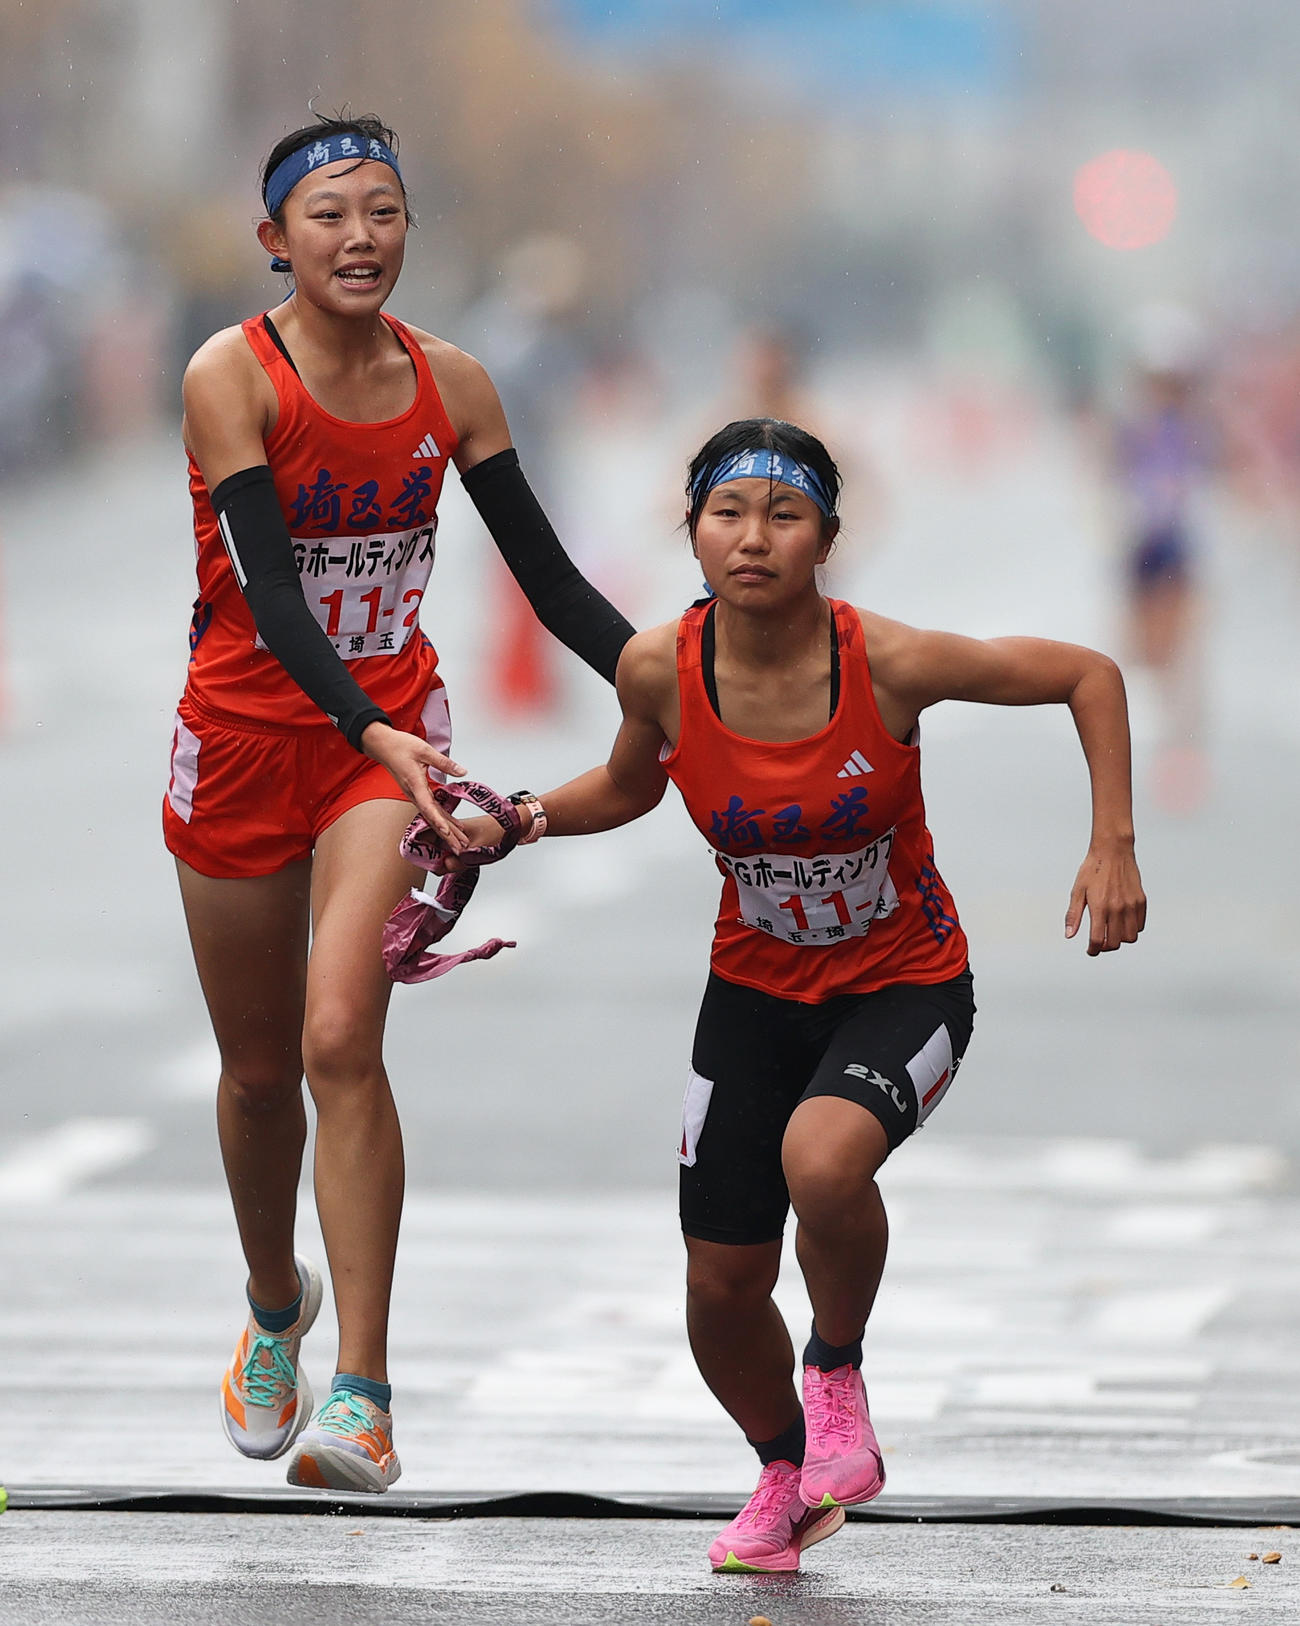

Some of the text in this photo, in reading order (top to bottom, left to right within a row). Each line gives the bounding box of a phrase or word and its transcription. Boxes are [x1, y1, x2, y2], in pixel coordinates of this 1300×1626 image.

[290, 466, 433, 531] 埼玉栄
[710, 786, 872, 848] 埼玉栄
